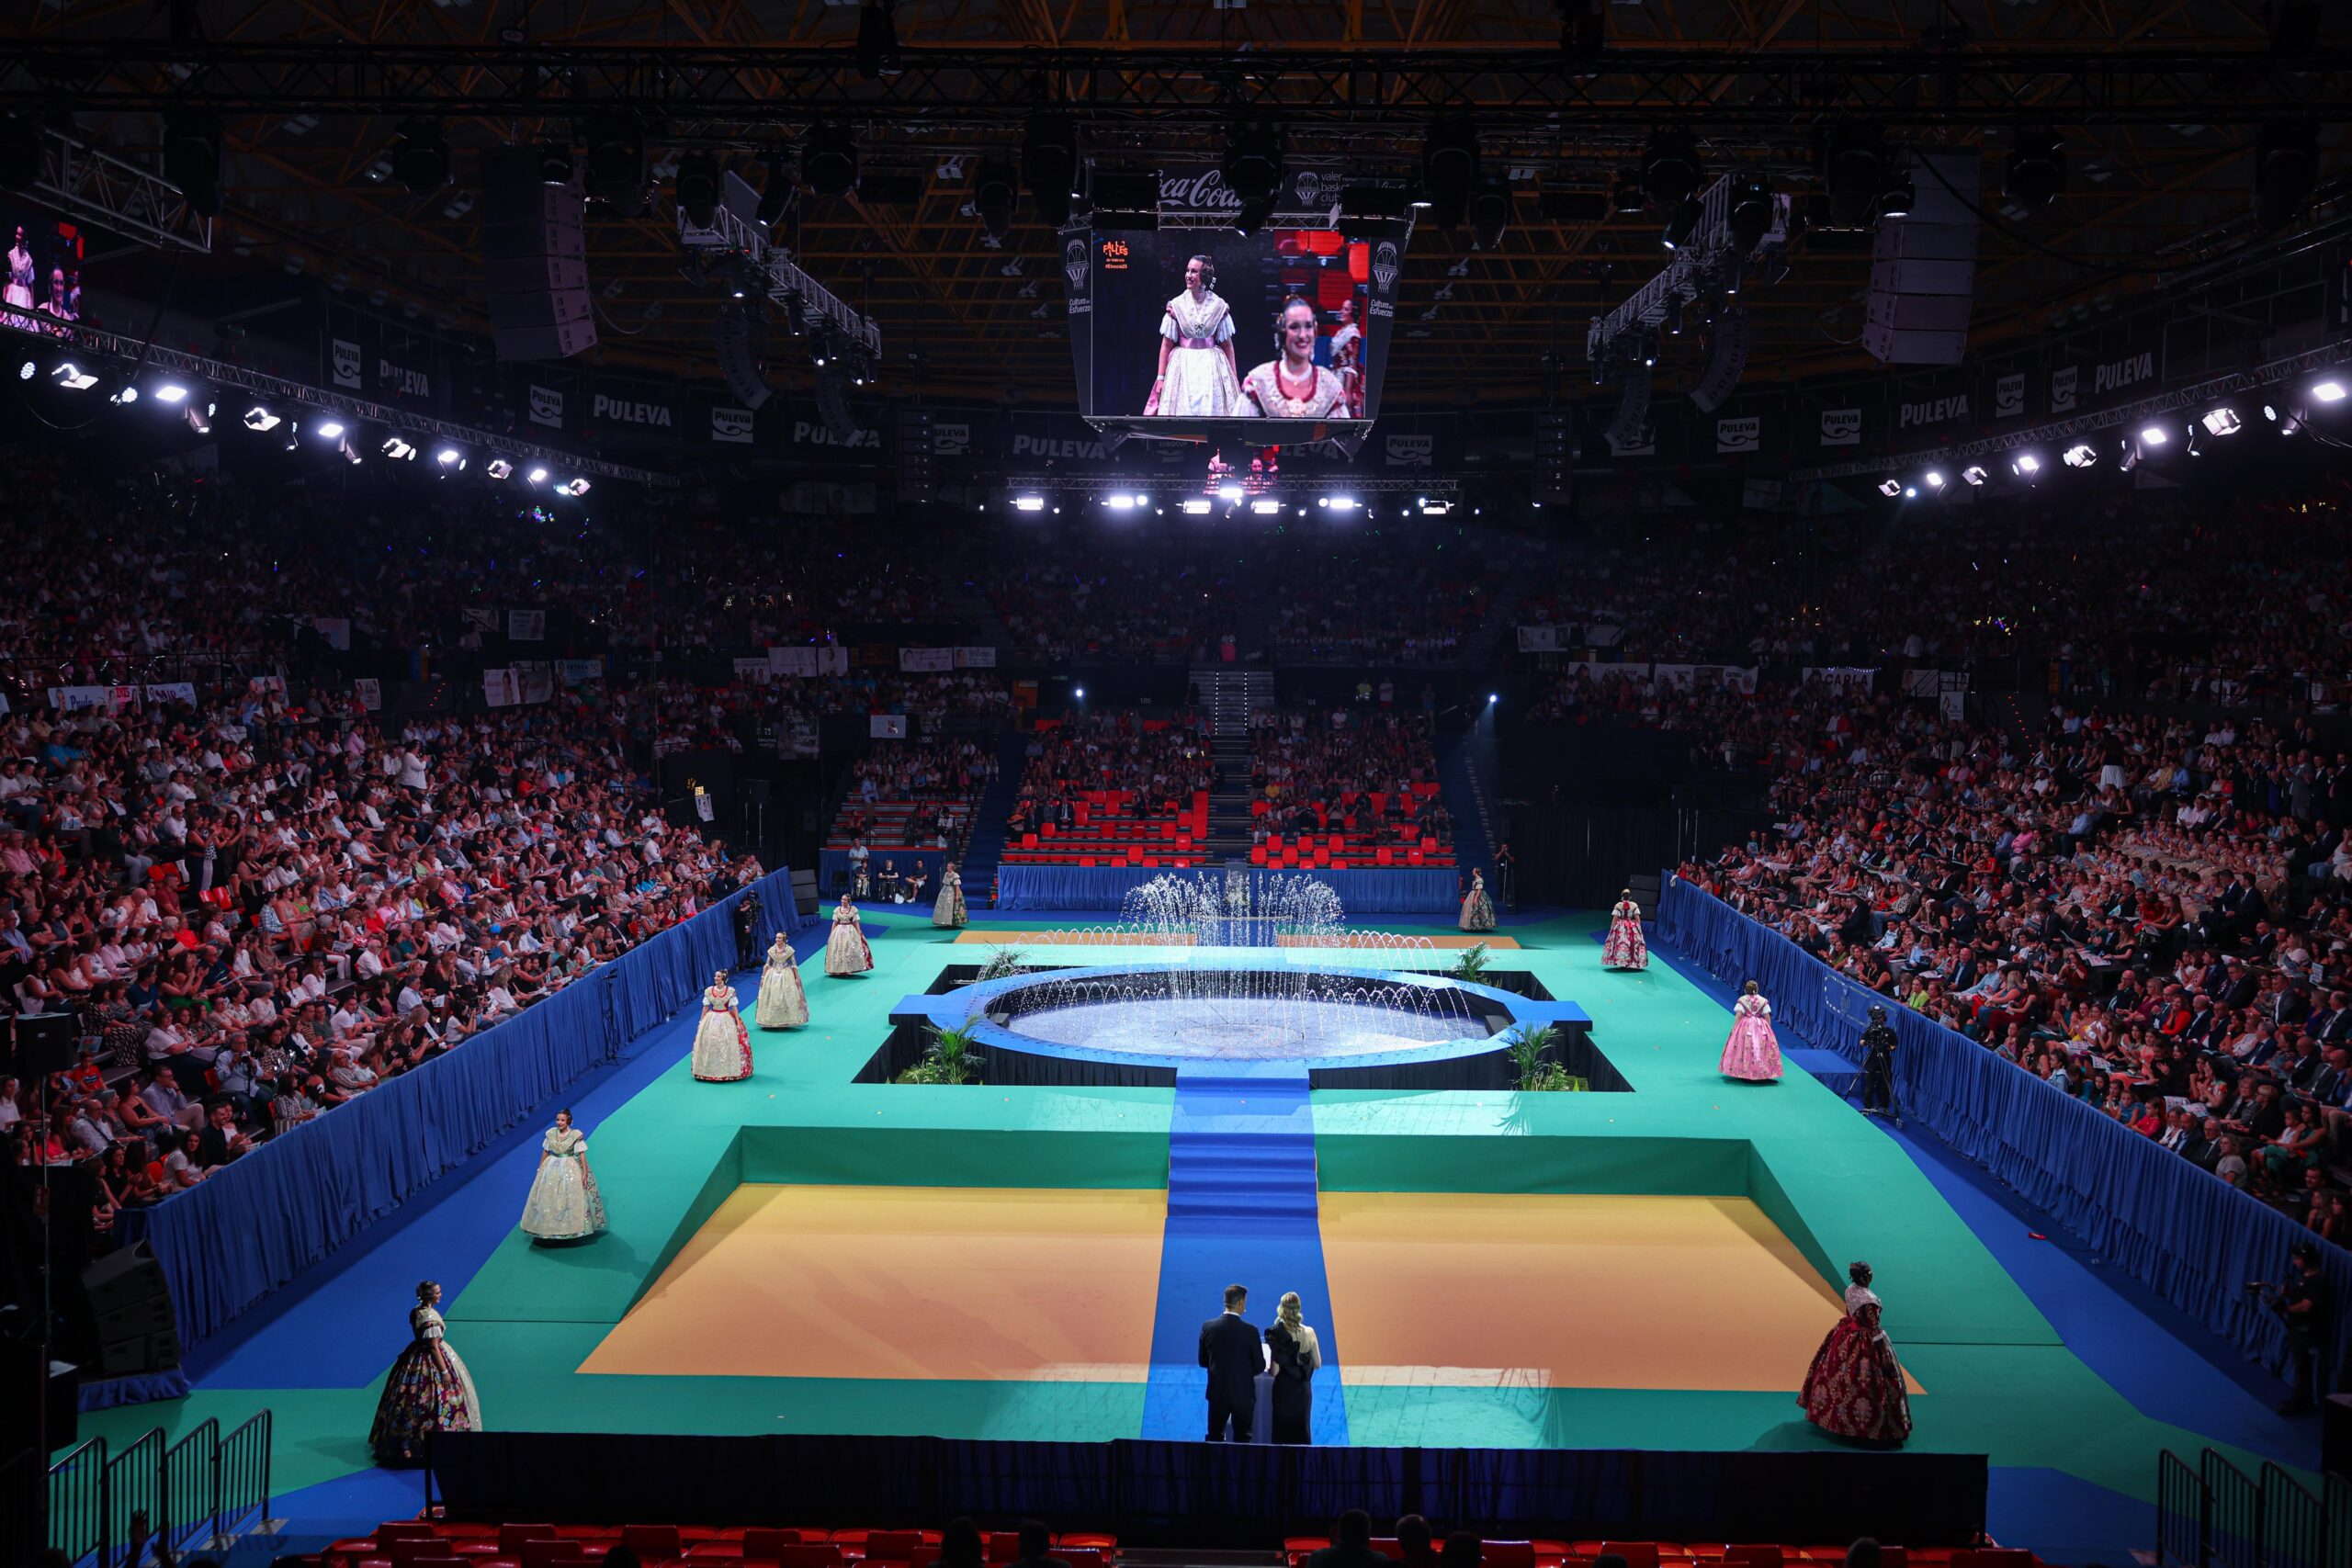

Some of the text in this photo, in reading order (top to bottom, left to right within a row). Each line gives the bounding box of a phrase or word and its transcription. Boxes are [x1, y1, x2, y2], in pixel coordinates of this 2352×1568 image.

[335, 345, 359, 362] PULEVA
[2095, 352, 2154, 394] PULEVA
[1997, 379, 2024, 394] PULEVA
[2054, 373, 2075, 389] PULEVA
[532, 390, 561, 409] PULEVA
[594, 394, 672, 426] PULEVA
[1899, 394, 1968, 428] PULEVA
[715, 412, 752, 425] PULEVA
[1824, 413, 1859, 426] PULEVA
[933, 428, 967, 438] ULEVA
[1720, 421, 1757, 434] PULEVA
[1012, 434, 1109, 459] PULEVA
[1389, 438, 1430, 450] PULEVA
[1825, 673, 1869, 686] CARLA
